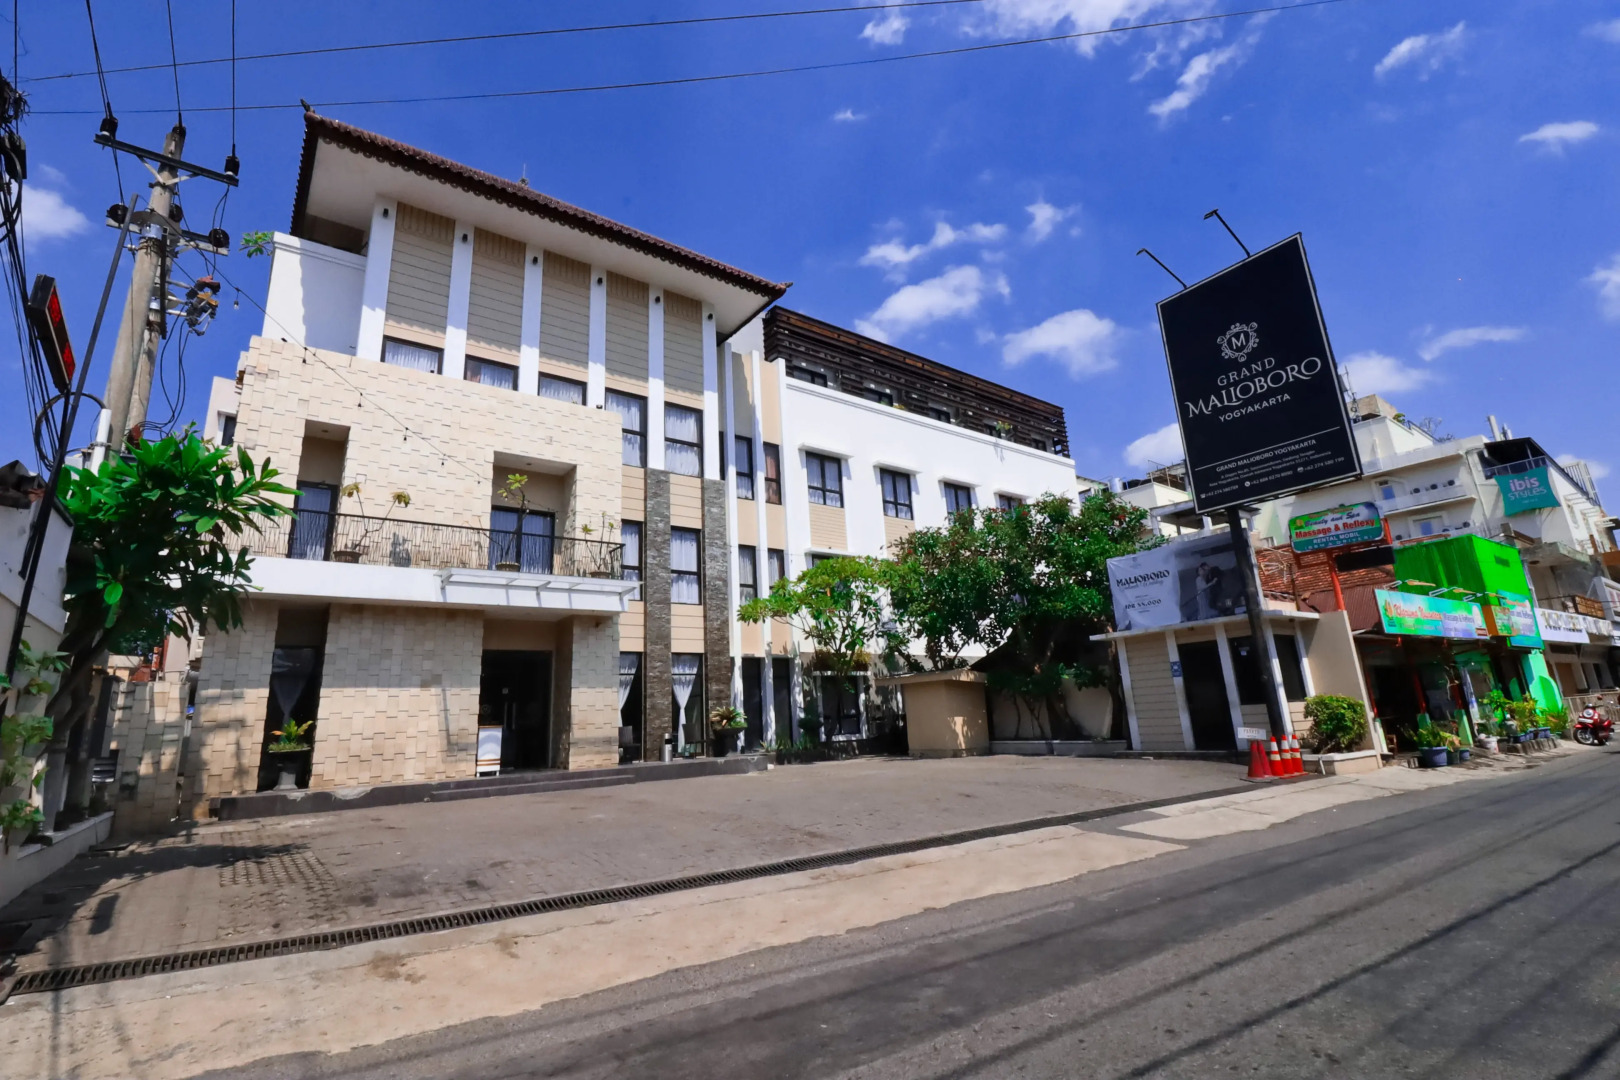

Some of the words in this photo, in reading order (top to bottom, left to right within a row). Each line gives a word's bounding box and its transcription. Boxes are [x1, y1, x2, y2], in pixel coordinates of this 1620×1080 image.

[1231, 333, 1246, 350] M
[1217, 357, 1275, 386] GRAND
[1184, 357, 1322, 418] MALIOBORO
[1218, 393, 1291, 423] YOGYAKARTA
[1216, 463, 1236, 472] GRAND
[1237, 452, 1273, 466] MALIOBORO
[1274, 440, 1316, 455] YOGYAKARTA
[1509, 476, 1540, 492] ibis
[1305, 518, 1328, 527] Beauty
[1346, 511, 1361, 520] Spa
[1295, 527, 1332, 539] Massage
[1334, 523, 1340, 531] &
[1343, 519, 1375, 530] Reflexy
[1313, 535, 1338, 543] RENTAL
[1339, 531, 1360, 539] MOBIL
[1116, 569, 1170, 587] MALIOBORO
